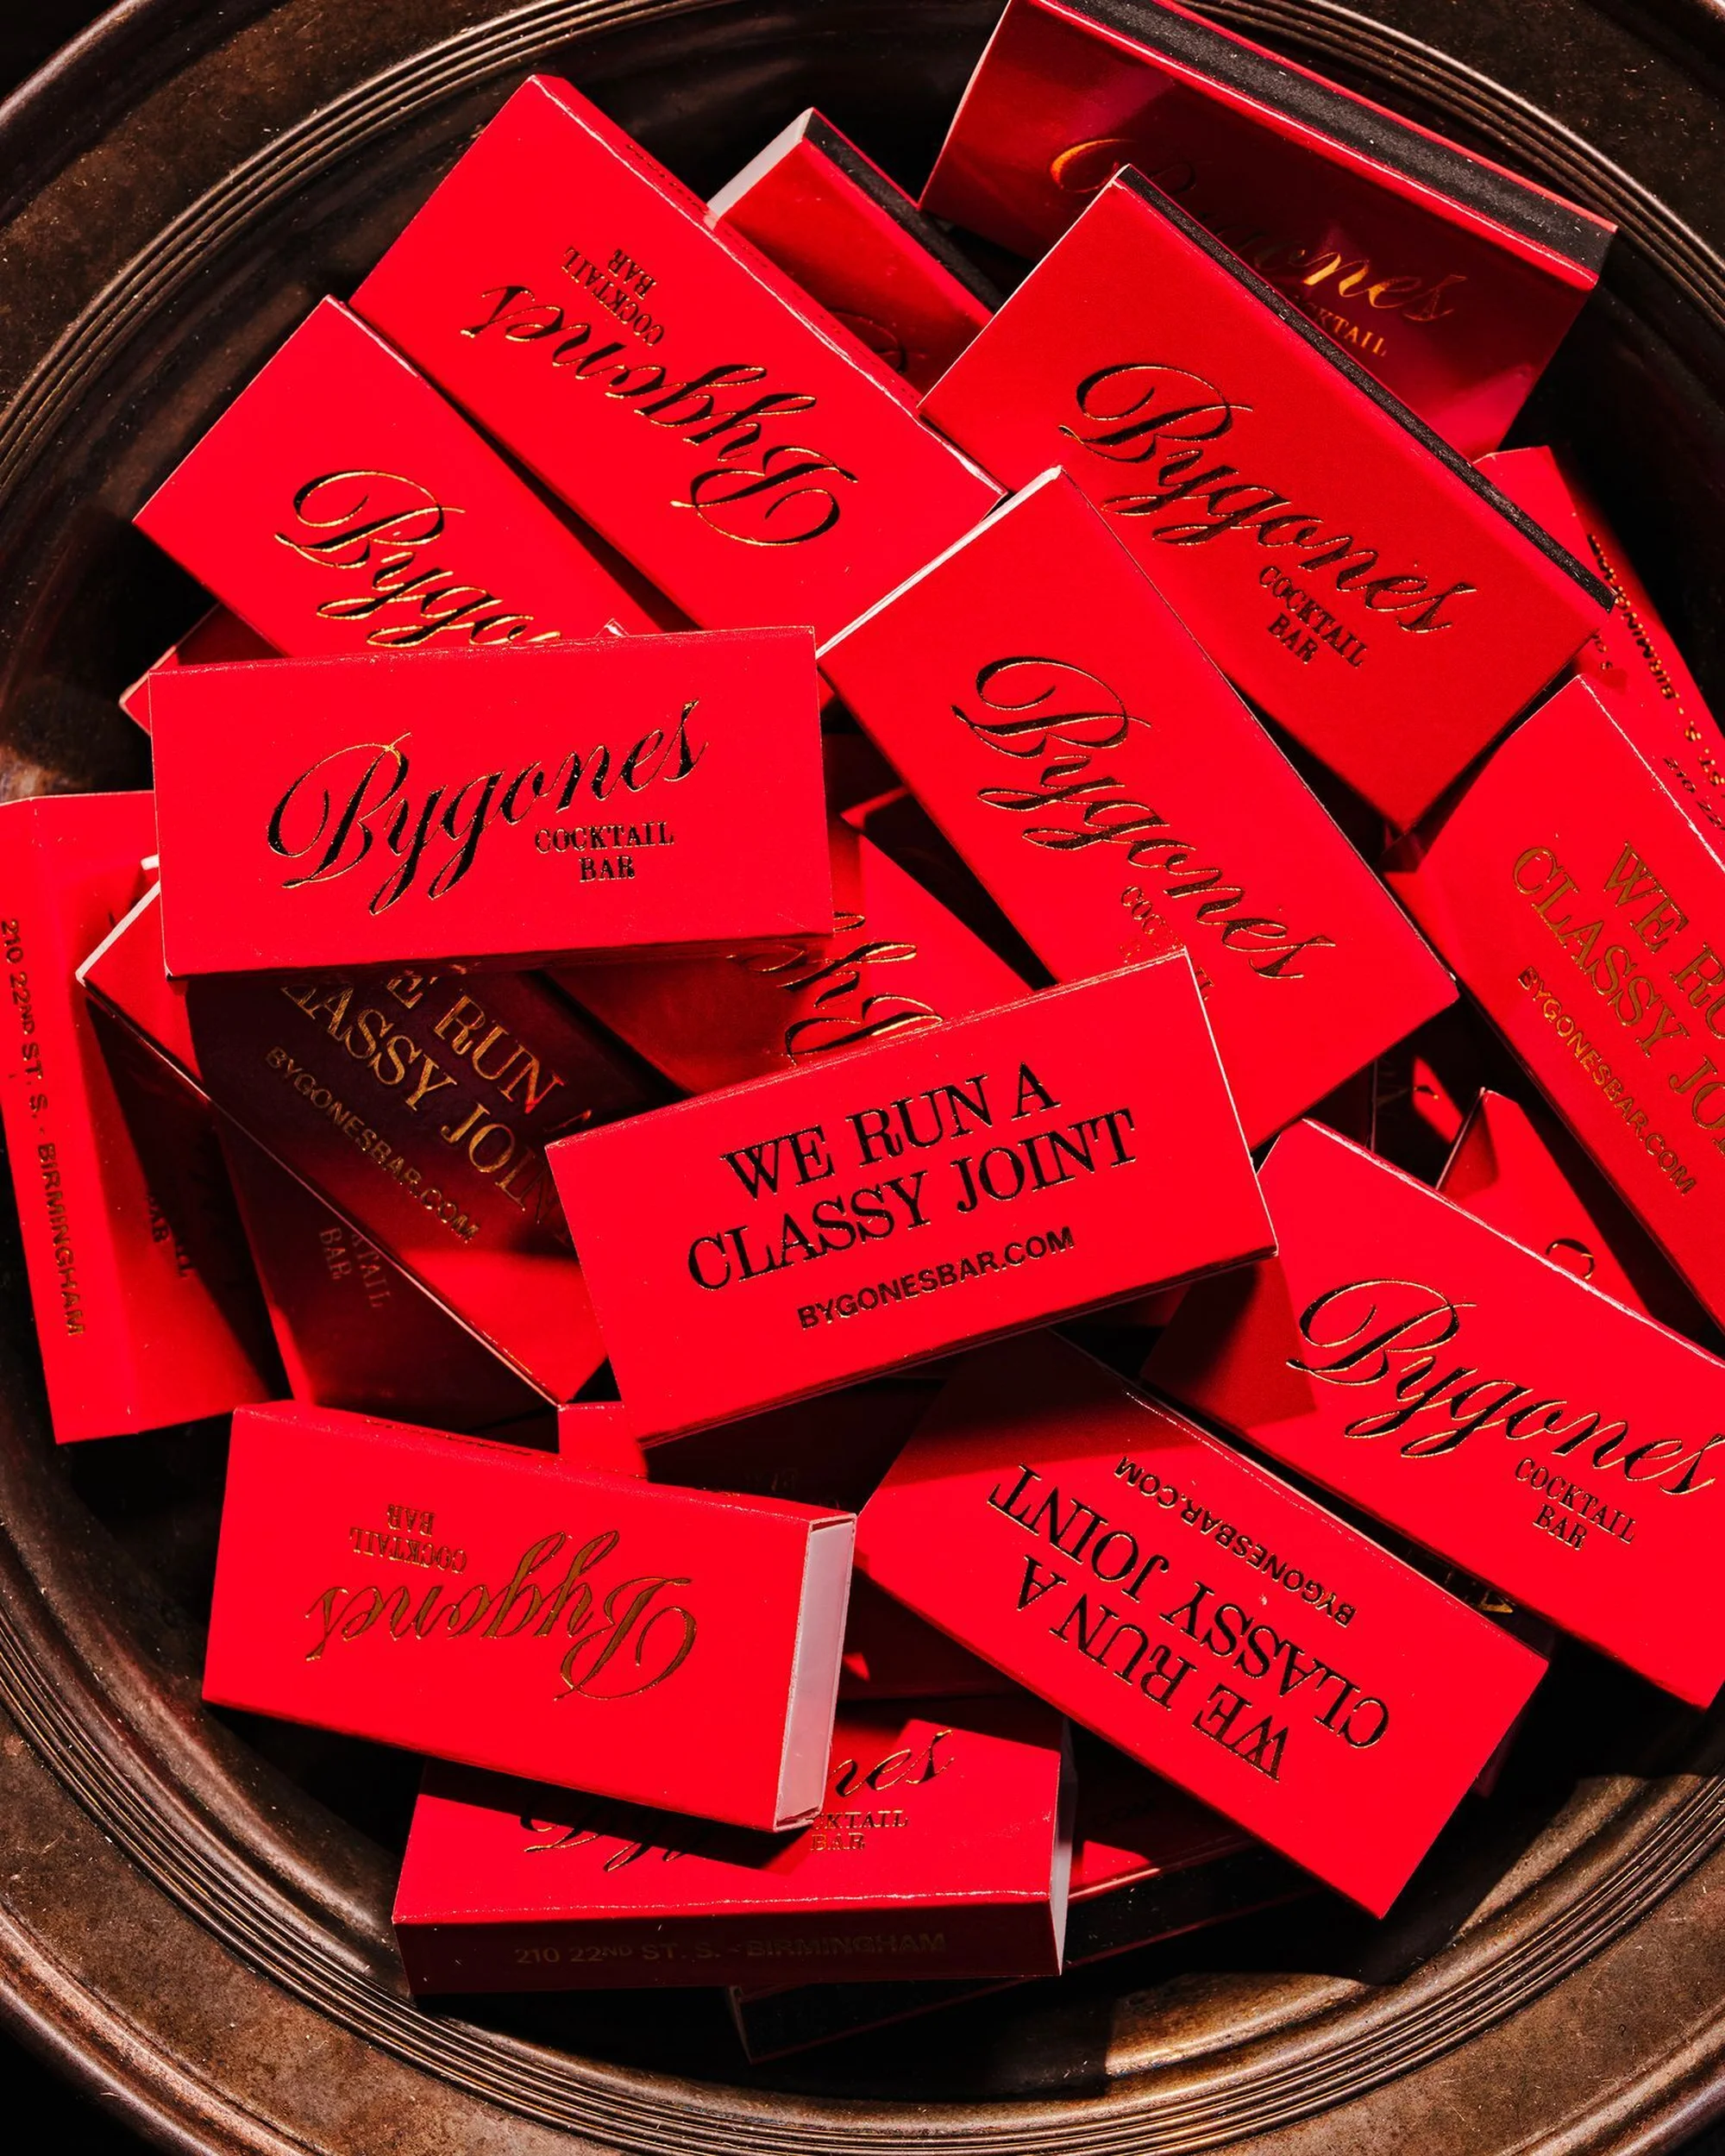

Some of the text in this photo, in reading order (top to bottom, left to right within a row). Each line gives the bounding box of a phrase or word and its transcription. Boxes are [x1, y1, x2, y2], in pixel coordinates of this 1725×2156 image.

[561, 246, 664, 347] COCKTAIL
[607, 248, 656, 300] BAR
[460, 285, 858, 547] Bygones
[1057, 363, 1477, 634] Bygones
[1258, 565, 1368, 669] COCKTAIL
[1267, 611, 1319, 665] BAR
[267, 698, 710, 916] Bygones
[534, 821, 675, 854] COCKTAIL
[579, 855, 637, 882] BAR
[950, 655, 1336, 980] Bygones
[1512, 845, 1690, 1058] CLASSY
[1603, 840, 1690, 954] WE
[433, 987, 567, 1114] RUN
[1517, 966, 1697, 1196] BYGONESBAR.COM
[265, 1045, 480, 1244] BYGONESBAR.COM
[719, 1062, 1062, 1200] WE RUN A
[37, 1142, 85, 1338] BIRMINGHAM
[687, 1107, 1137, 1290] CLASSY JOINT
[796, 1225, 1076, 1331] BYGONESBAR.COM
[1285, 1279, 1725, 1495] Bygones
[348, 1526, 468, 1575] COCKTAIL
[386, 1503, 436, 1536] BAR
[1113, 1455, 1358, 1627] BYGONESBAR.COM
[1515, 1457, 1636, 1545] COCKTAIL
[1532, 1503, 1588, 1551] BAR
[305, 1530, 698, 1702] Bygones
[986, 1463, 1389, 1750] CLASSY JOINT
[1016, 1554, 1291, 1782] WE RUN A
[811, 1832, 866, 1852] BAR
[514, 1946, 561, 1966] 210
[745, 1931, 947, 1959] BIRMINGHAM
